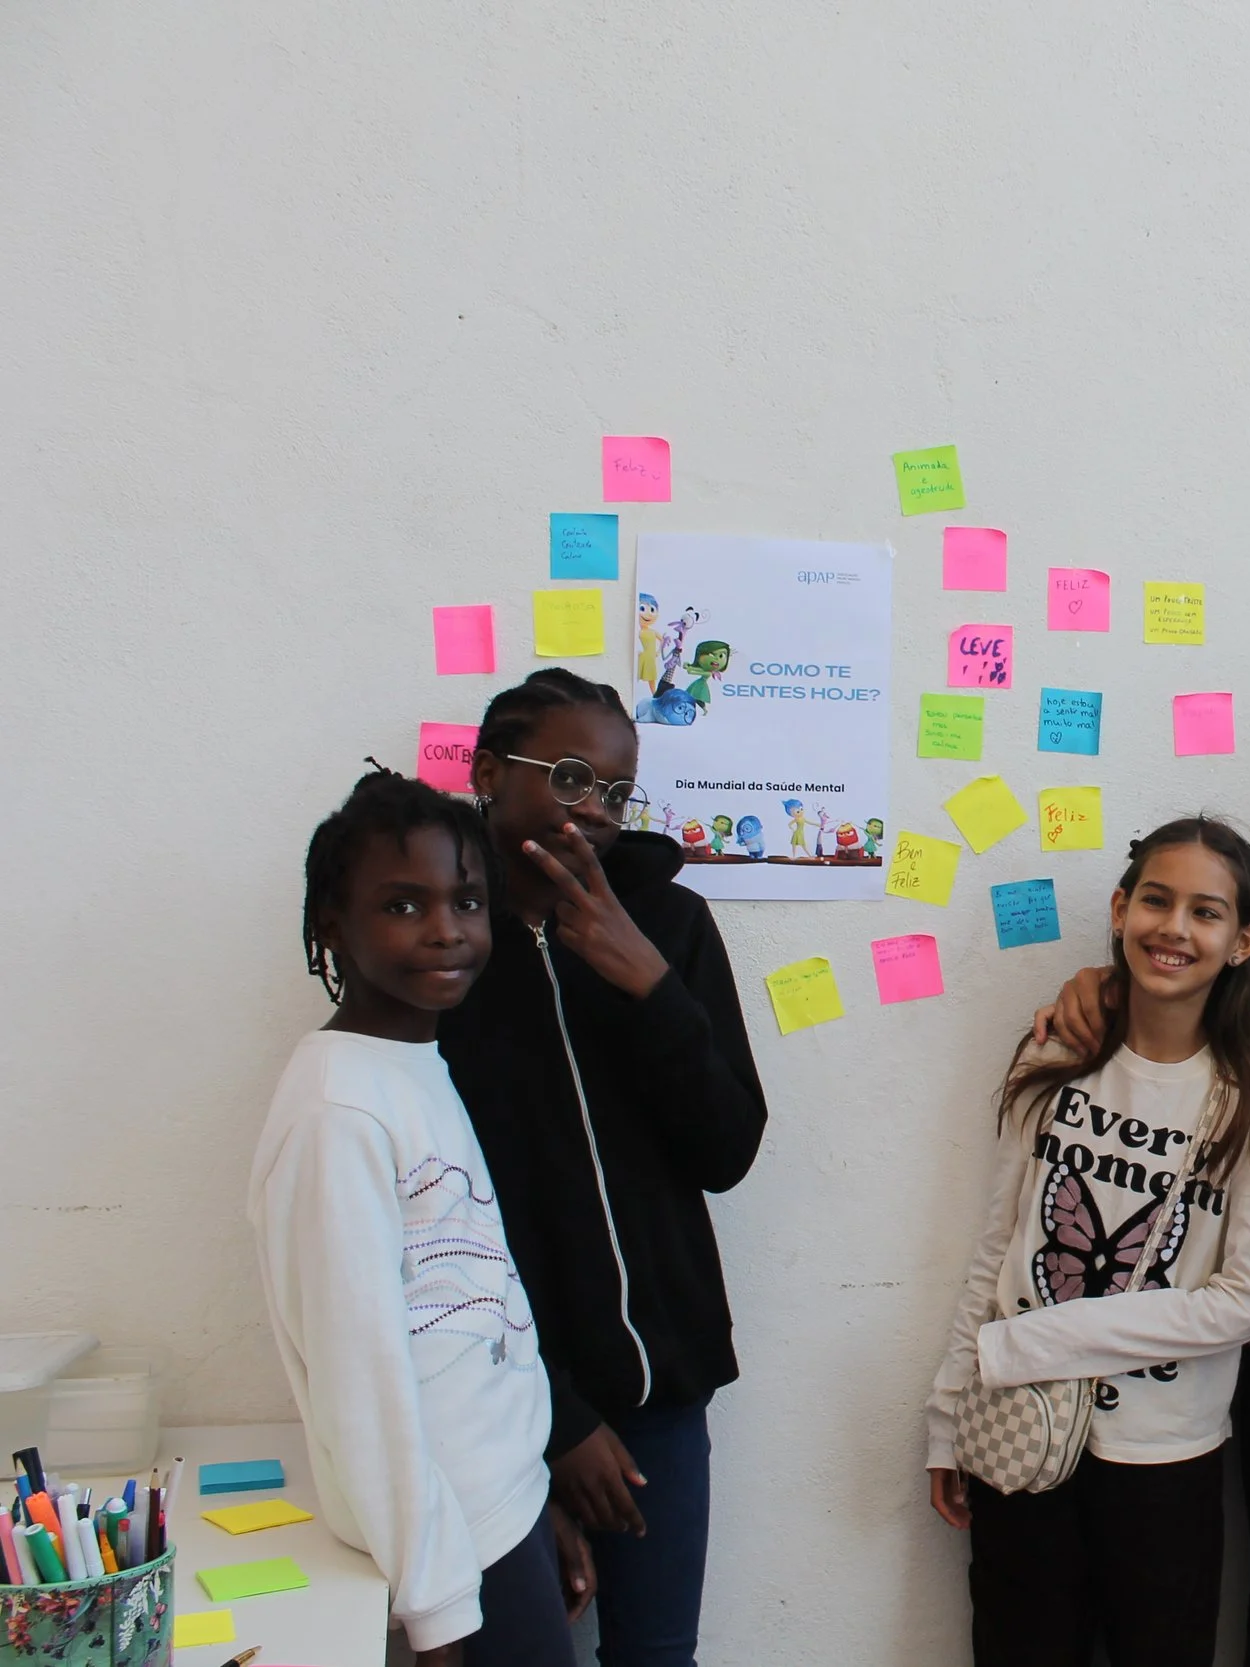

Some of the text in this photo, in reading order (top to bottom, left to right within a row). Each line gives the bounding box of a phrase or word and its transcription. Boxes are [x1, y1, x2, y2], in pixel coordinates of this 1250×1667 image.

[1056, 580, 1090, 591] FELIZ
[960, 637, 1005, 658] LEVE
[750, 662, 852, 679] COMO TE
[722, 684, 881, 702] SENTES HOJE?
[424, 744, 476, 765] CONTEN
[675, 779, 845, 793] Dia Mundial da Saúde Mental
[1044, 802, 1088, 823] Feliz
[891, 871, 921, 889] Feliz
